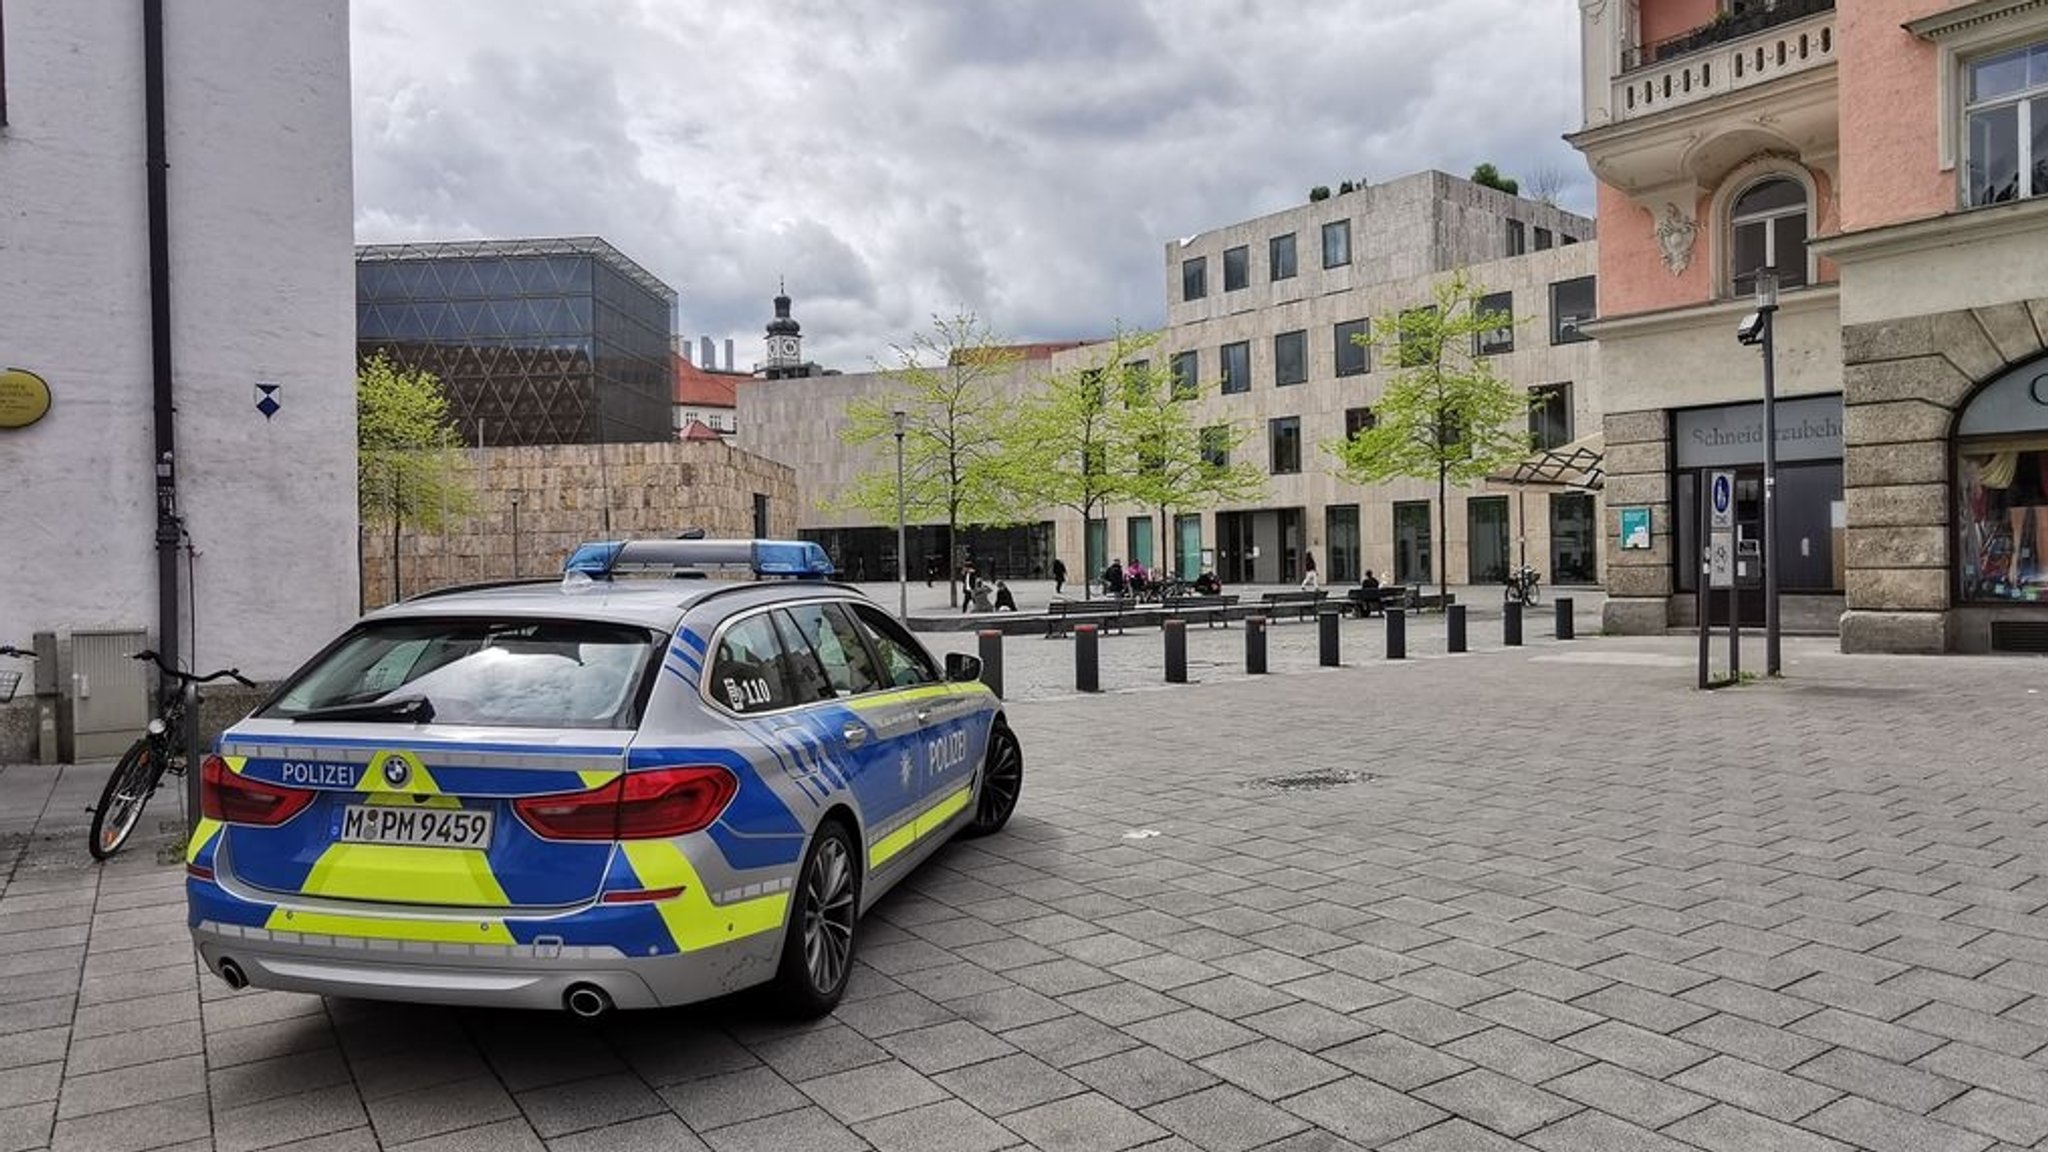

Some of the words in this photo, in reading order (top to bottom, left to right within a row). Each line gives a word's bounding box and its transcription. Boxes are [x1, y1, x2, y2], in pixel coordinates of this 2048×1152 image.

[1692, 417, 1843, 447] Schneidzubeh
[742, 678, 771, 704] 110
[929, 730, 966, 777] POLIZEI
[282, 762, 355, 785] POLIZEI
[421, 813, 487, 843] 9459
